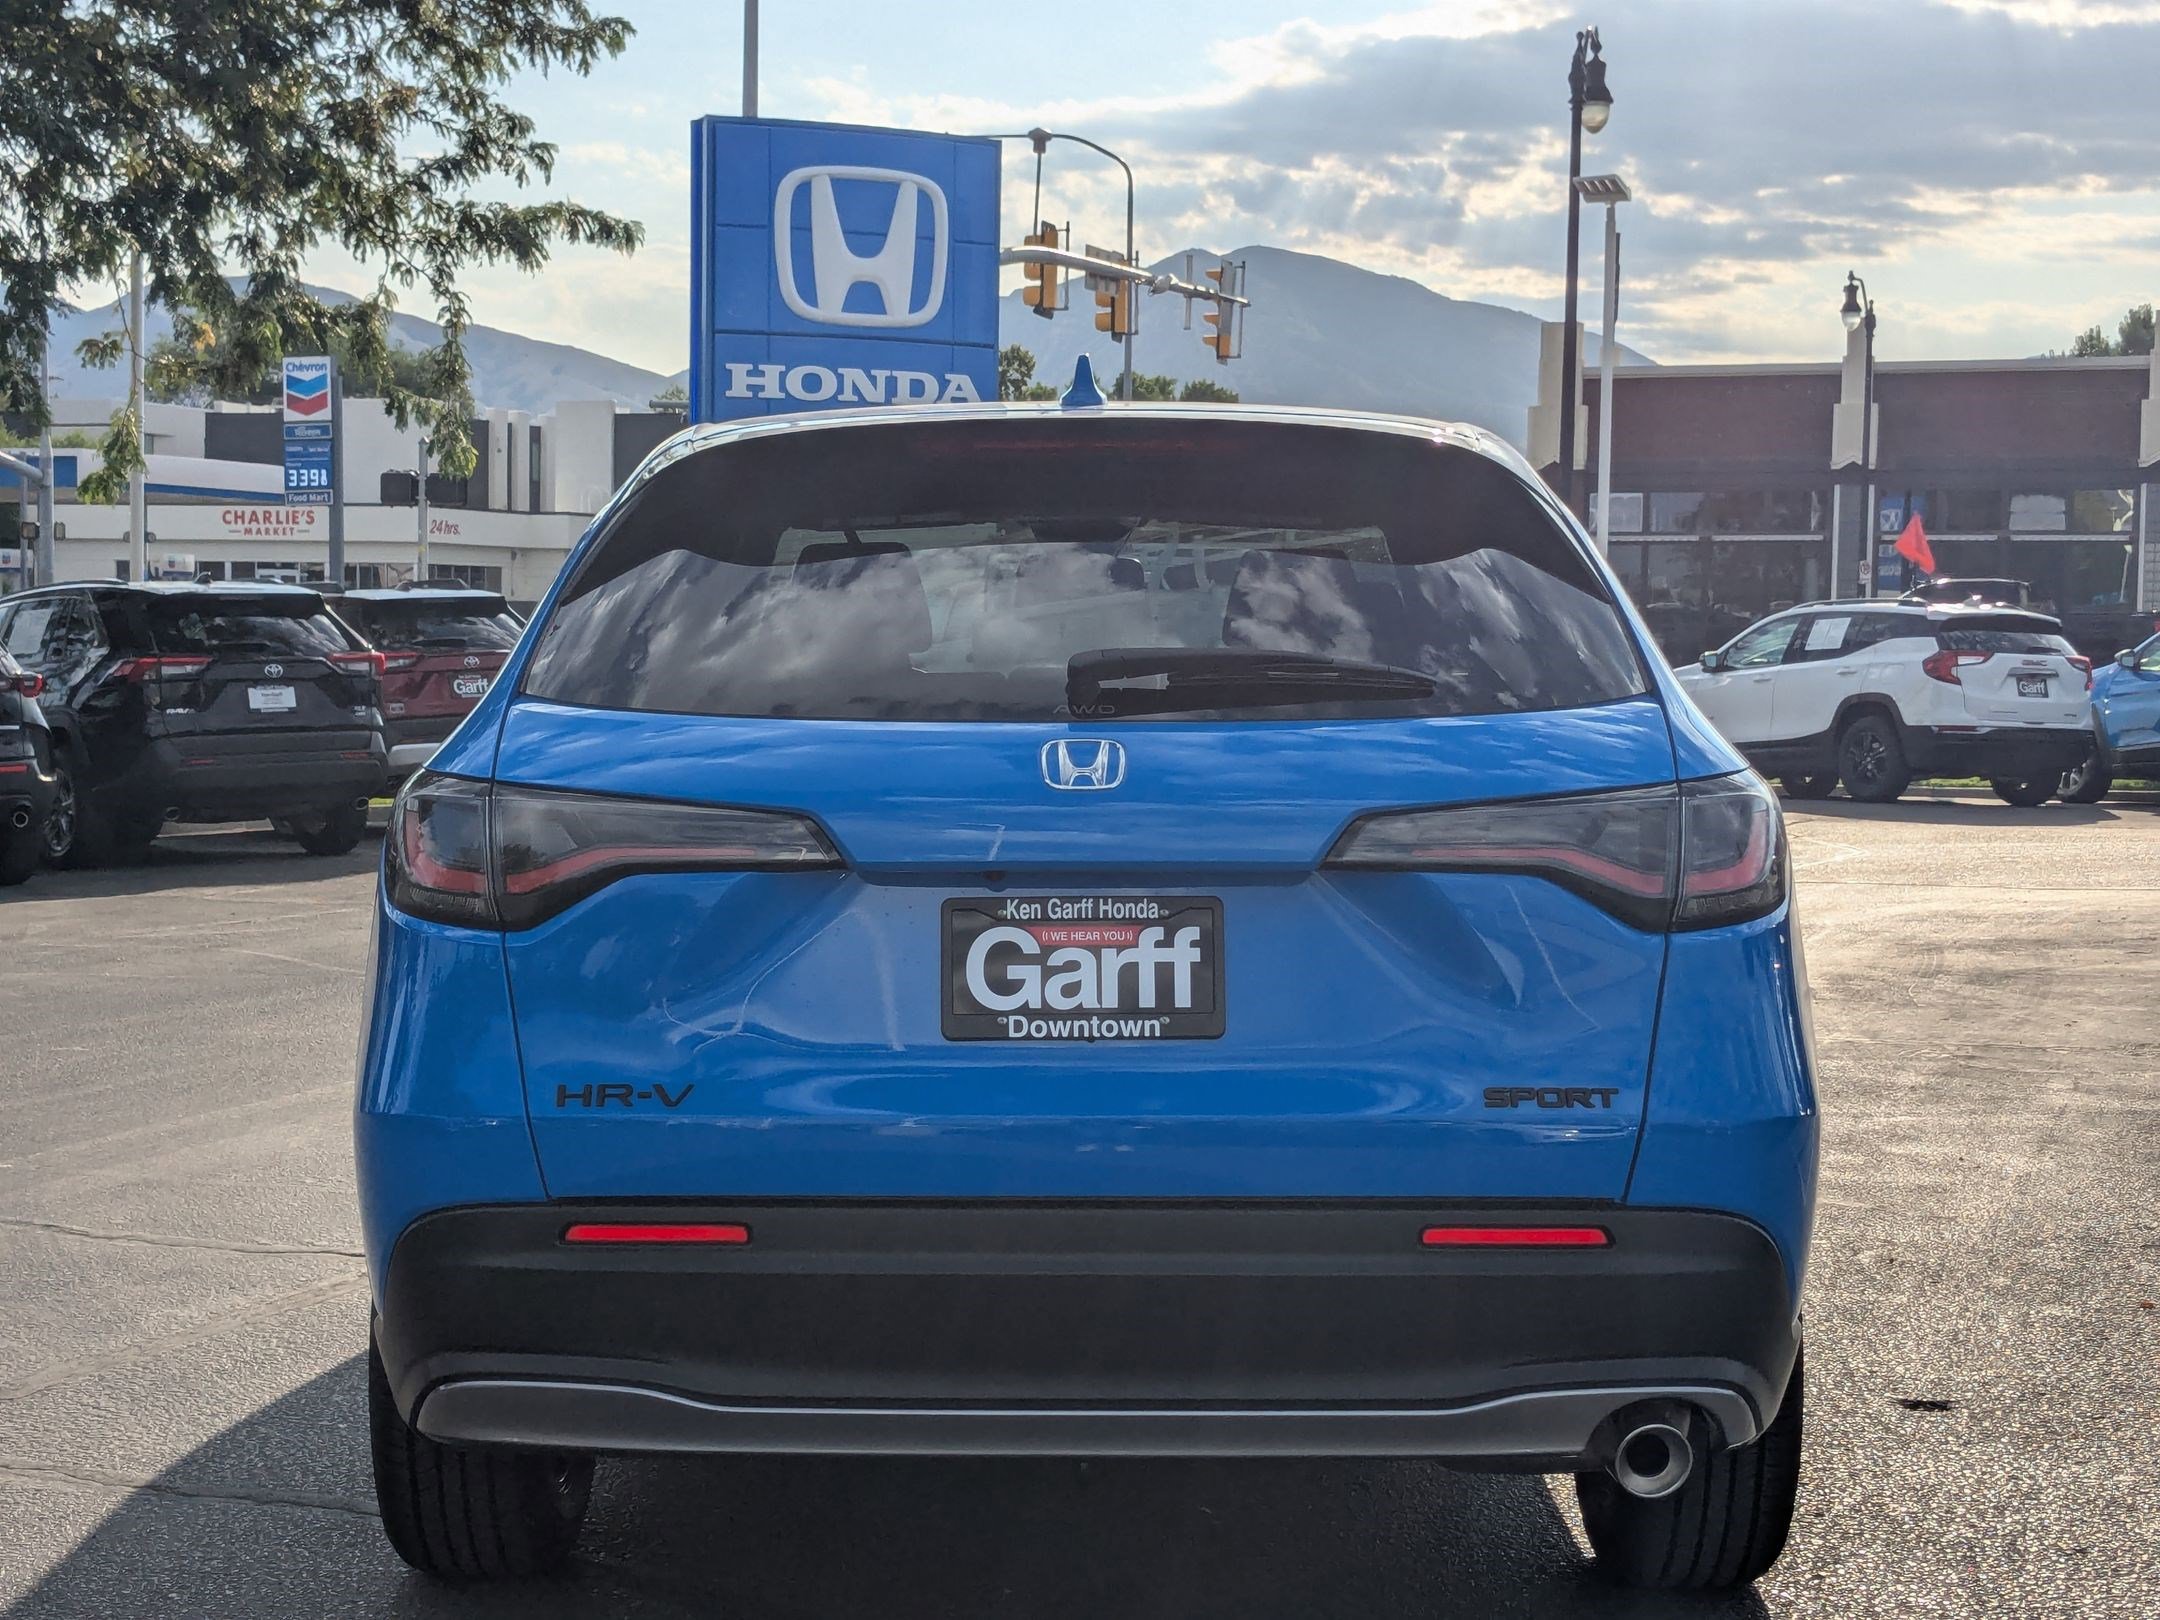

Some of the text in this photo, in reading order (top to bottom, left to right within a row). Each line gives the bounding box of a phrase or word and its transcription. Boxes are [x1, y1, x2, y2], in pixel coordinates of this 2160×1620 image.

[286, 361, 328, 373] Chevron
[724, 363, 982, 404] HONDA
[288, 493, 308, 502] Food
[222, 509, 316, 526] CHARLIE'S
[244, 527, 296, 537] MARKET
[430, 520, 444, 534] 24
[1053, 704, 1116, 714] AWD
[1006, 898, 1159, 920] Ken Garff Honda
[1051, 931, 1125, 941] WE HEAR YOU
[966, 926, 1201, 1011] Garff
[1008, 1015, 1160, 1038] Downtown
[556, 1083, 695, 1108] HR-V
[1483, 1087, 1620, 1109] SPORT
